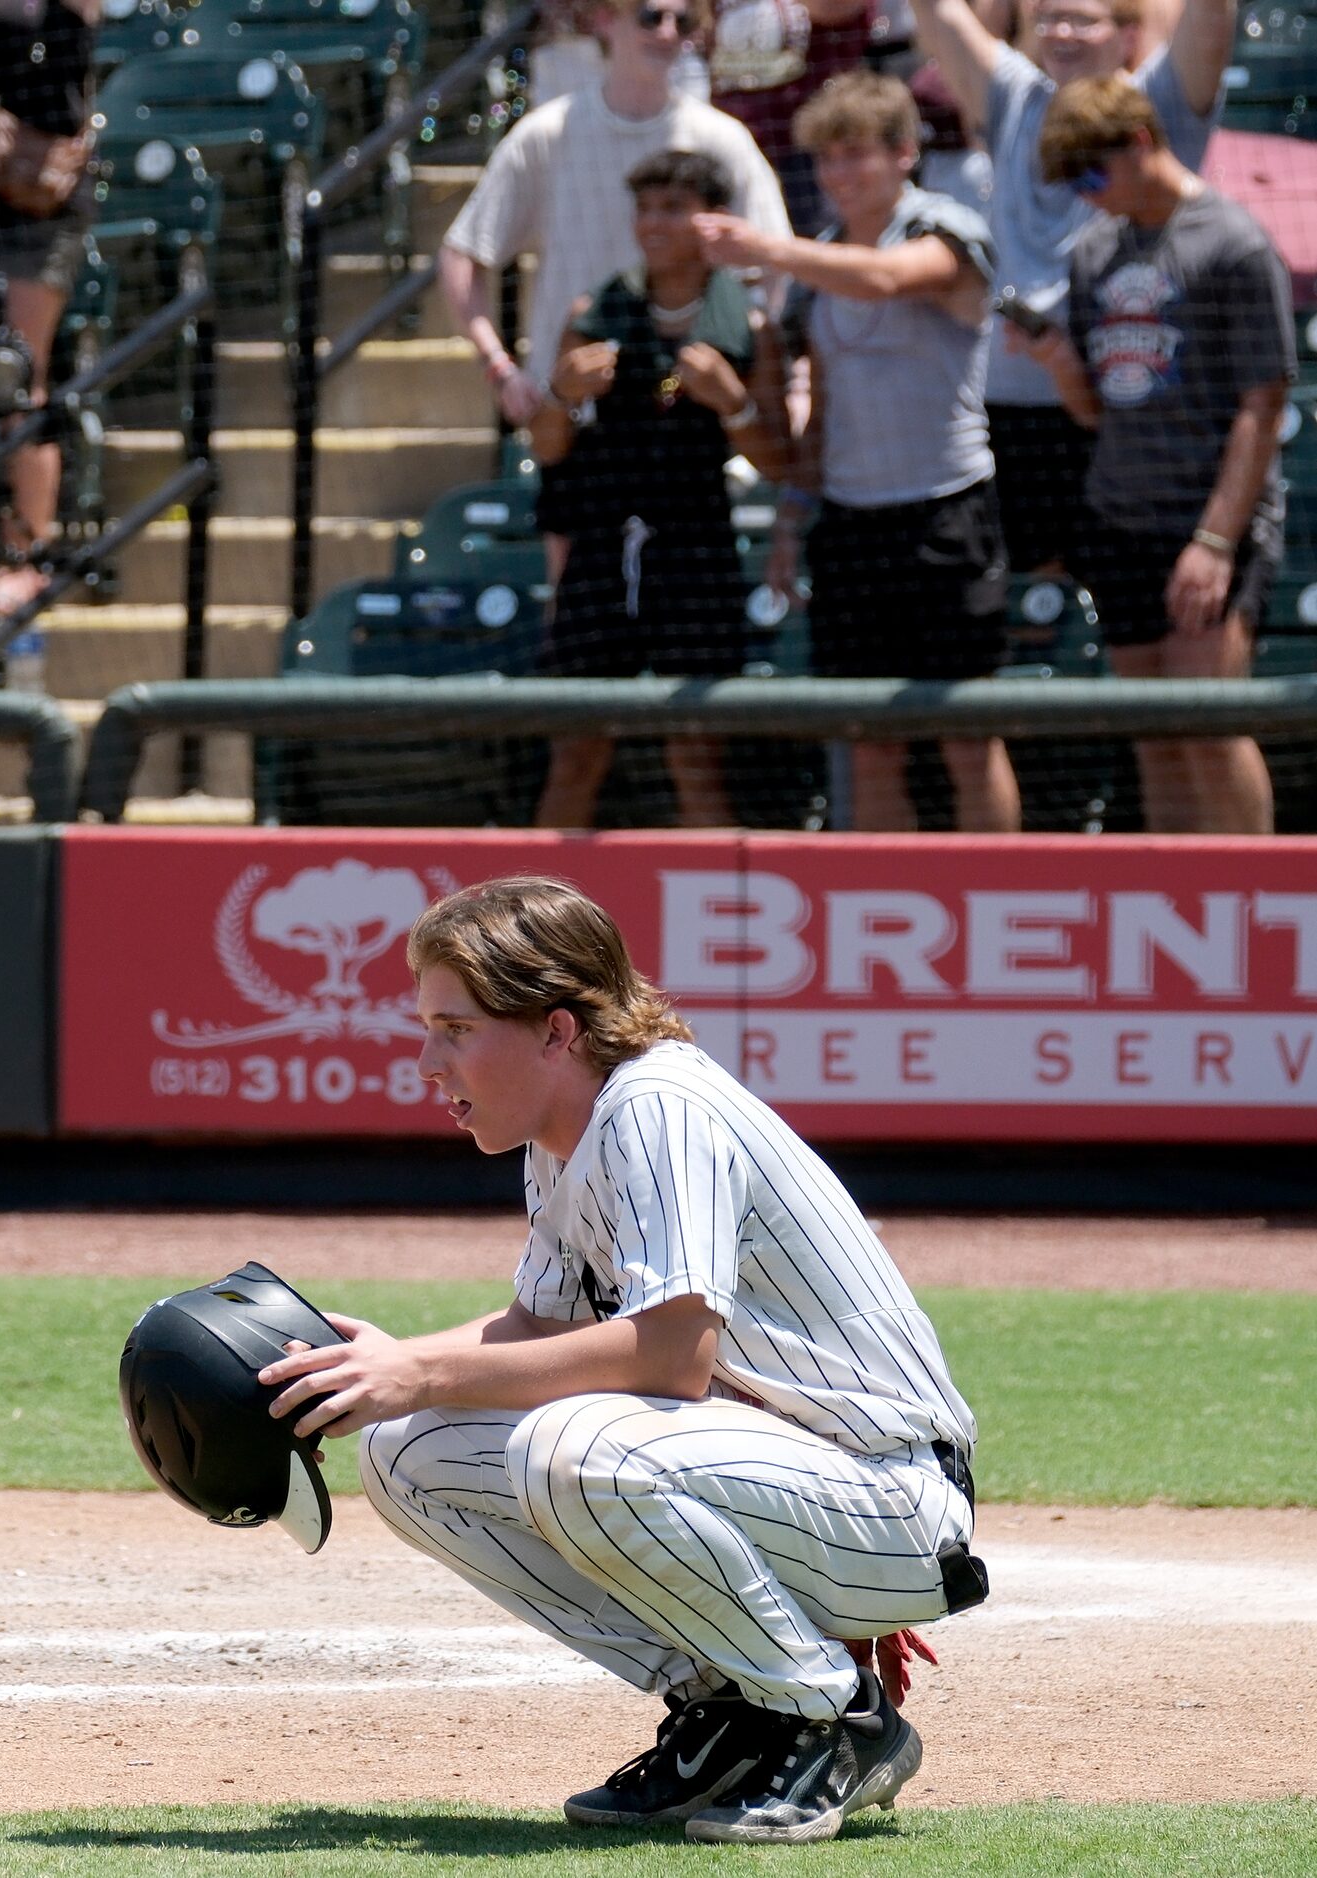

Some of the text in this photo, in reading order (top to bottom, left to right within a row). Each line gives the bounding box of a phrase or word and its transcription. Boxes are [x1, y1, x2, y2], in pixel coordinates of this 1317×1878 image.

[658, 868, 1317, 999] BRENT
[150, 1055, 448, 1105] (512) 310-8
[738, 1028, 1314, 1085] REE SERV
